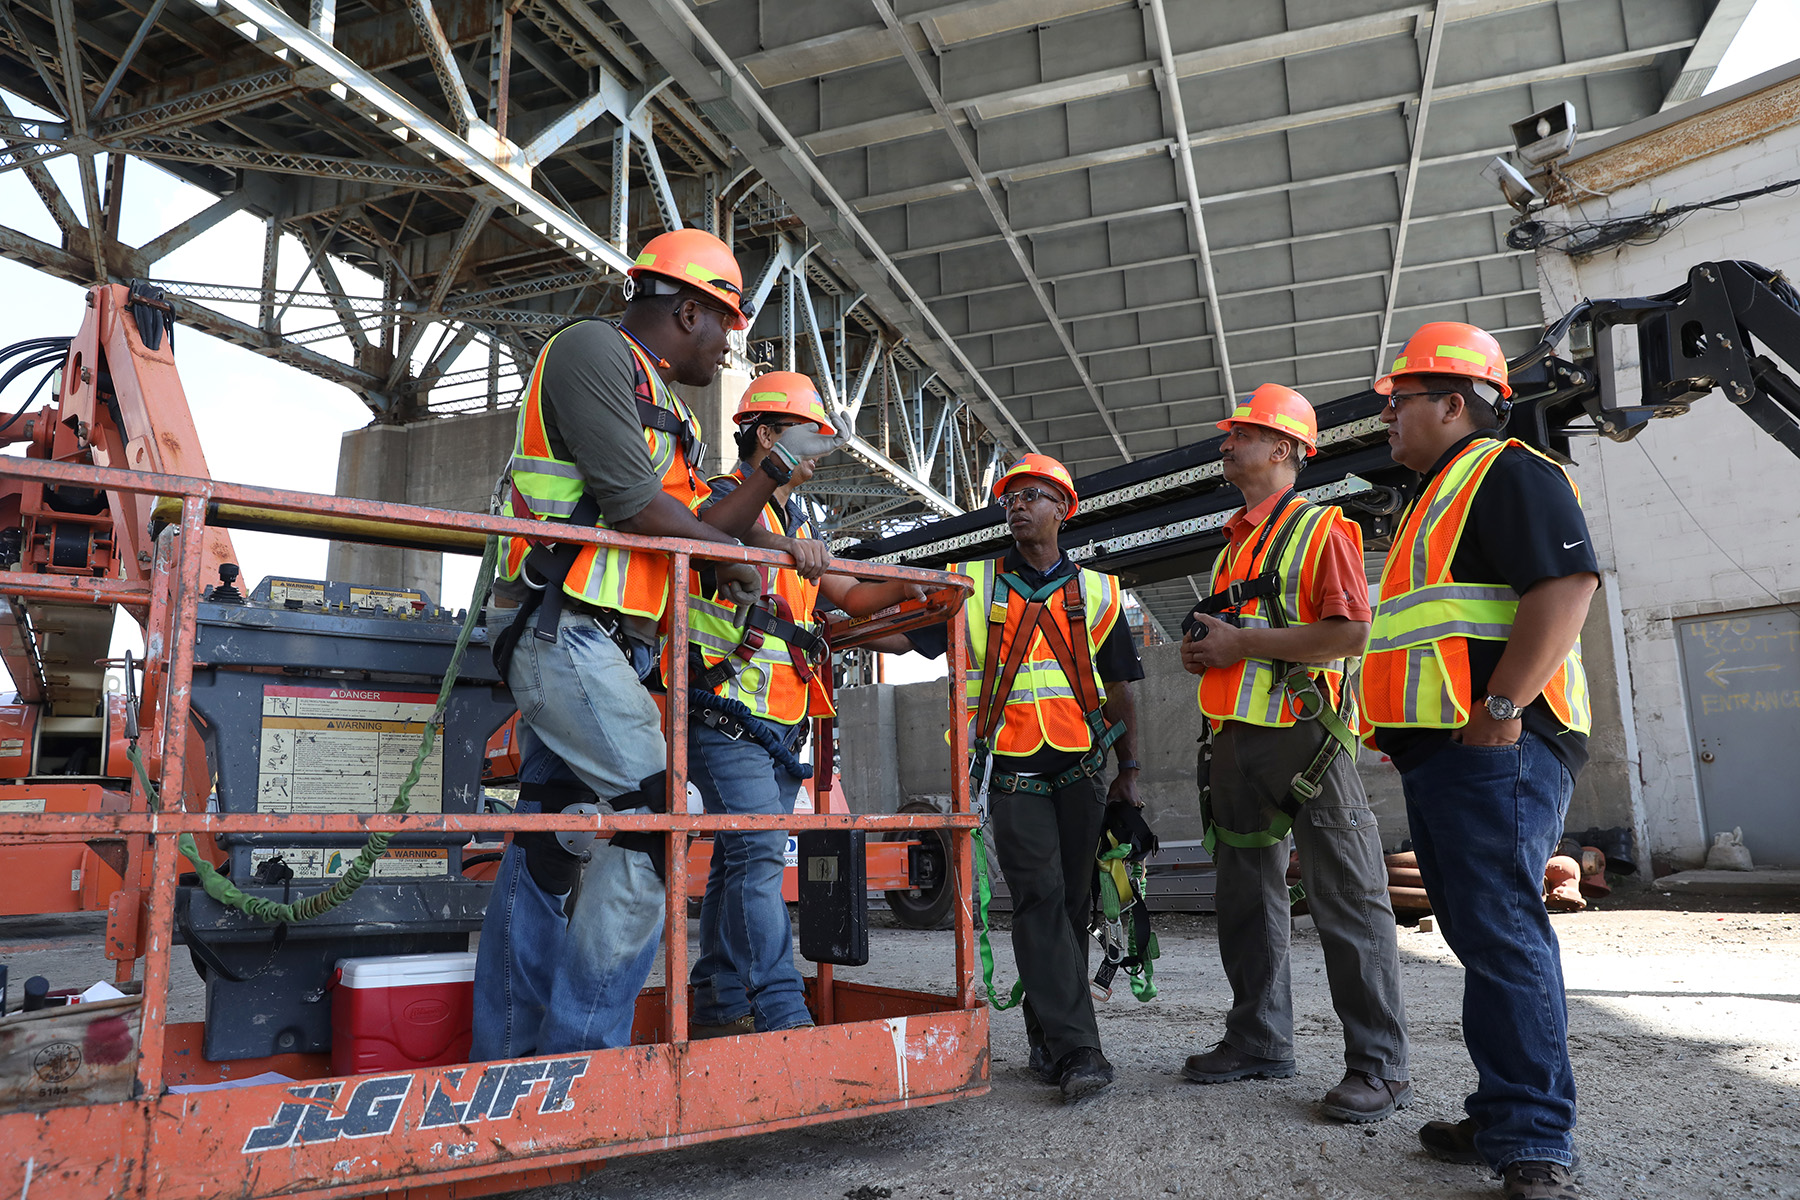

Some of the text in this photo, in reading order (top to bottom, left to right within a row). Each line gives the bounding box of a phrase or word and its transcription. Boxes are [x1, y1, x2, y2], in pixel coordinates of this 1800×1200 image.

[286, 582, 315, 590] WARNING
[375, 590, 403, 598] WARNING
[1690, 619, 1751, 641] 470
[1704, 630, 1800, 657] SCOTT
[339, 690, 381, 700] DANGER
[1701, 690, 1800, 715] ENTRANCE
[336, 721, 383, 731] WARNING
[394, 850, 437, 858] WARNING
[44, 1044, 73, 1054] KLEIN
[39, 1086, 69, 1098] 5144
[242, 1055, 591, 1154] JLG LIFT
